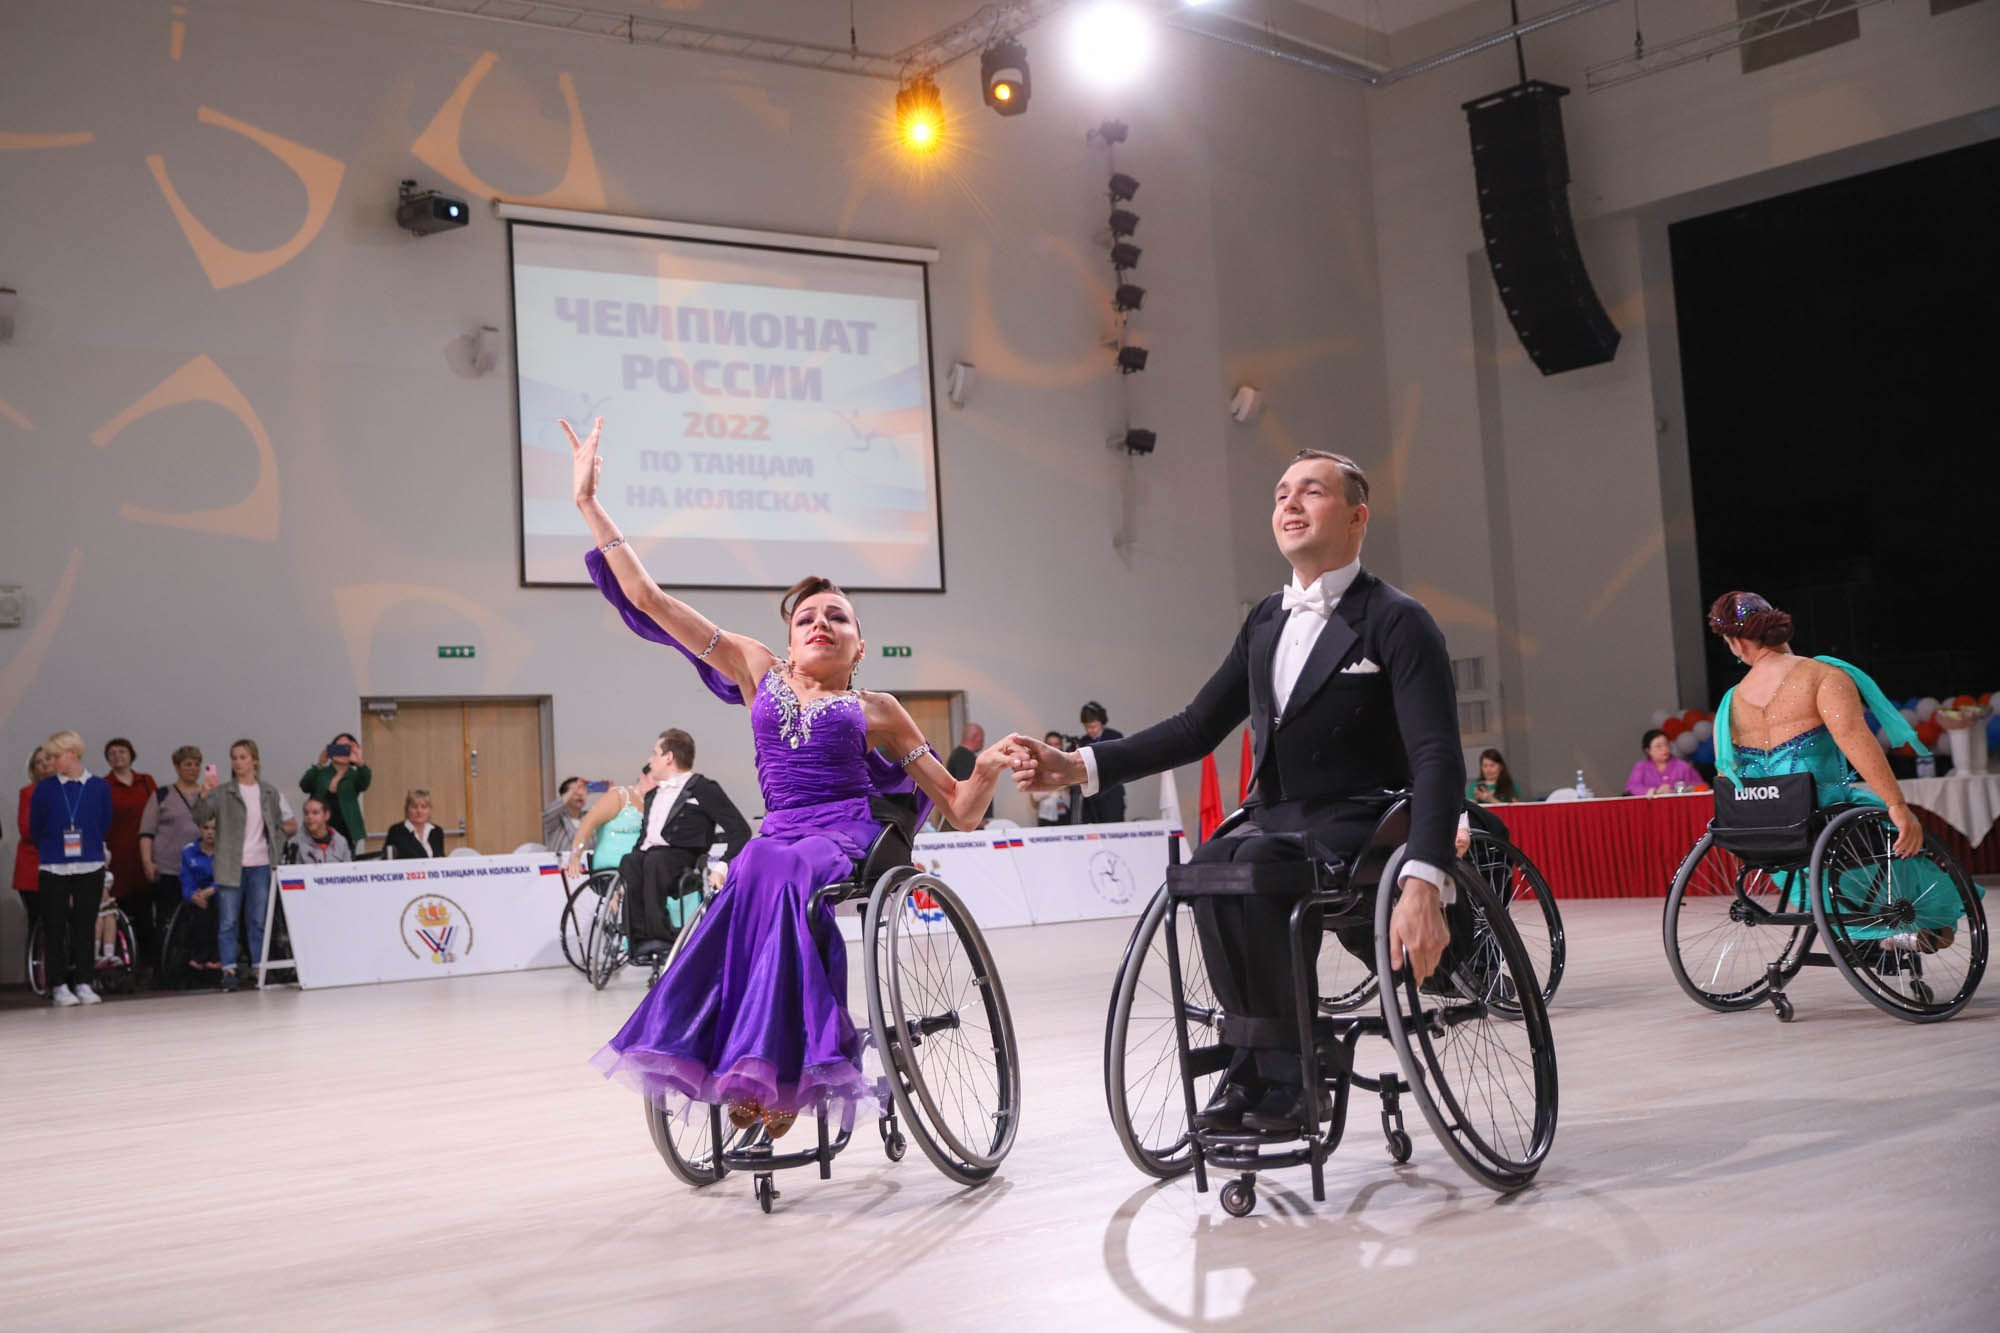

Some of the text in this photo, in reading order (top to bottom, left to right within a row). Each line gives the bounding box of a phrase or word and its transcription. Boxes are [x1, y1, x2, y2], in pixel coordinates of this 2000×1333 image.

[554, 296, 878, 355] ЧЕМПИОНАТ
[621, 353, 824, 401] РОССИИ
[682, 411, 771, 441] 2022
[639, 449, 814, 480] ПО ТАНЦАМ
[625, 485, 833, 513] НА КОЛЯСКАХ
[1734, 785, 1780, 801] LUKOR
[313, 866, 531, 885] ЧЕМПИОНАТ РОССИИ 2022 ПО ТАНЦАМ НА КОЛЯСКАХ
